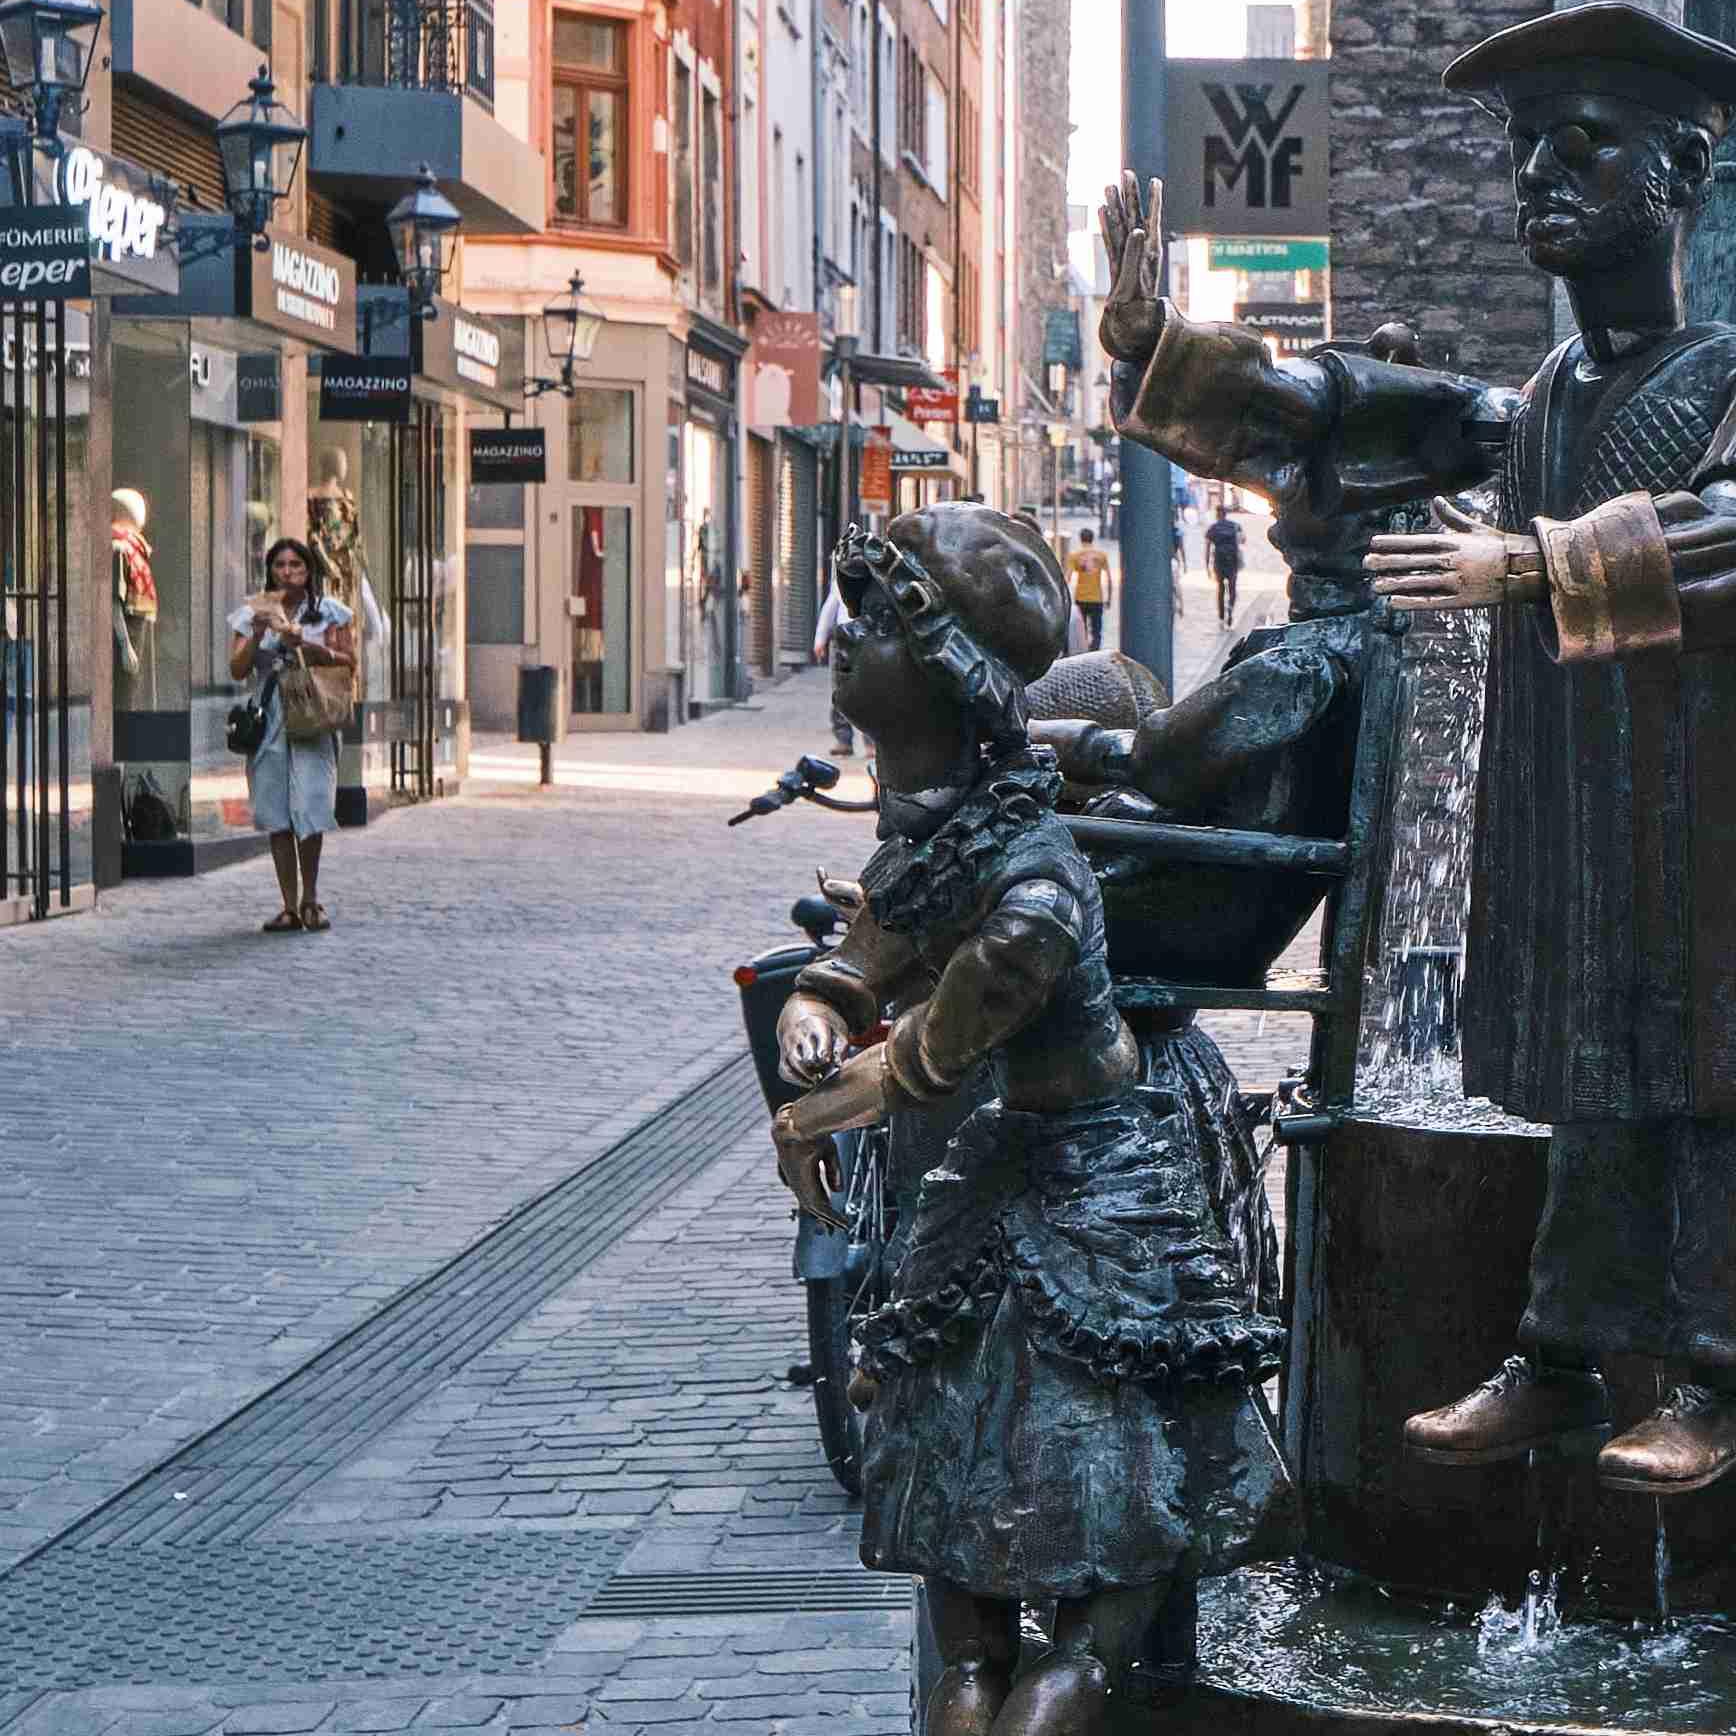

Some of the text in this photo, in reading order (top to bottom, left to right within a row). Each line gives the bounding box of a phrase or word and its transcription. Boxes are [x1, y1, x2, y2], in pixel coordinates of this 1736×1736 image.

[1201, 83, 1304, 207] WMF
[0, 257, 85, 292] eper
[272, 241, 340, 305] MAGAZZINO
[324, 375, 408, 392] MAGAZZINO
[473, 446, 543, 458] MAGAZZINO
